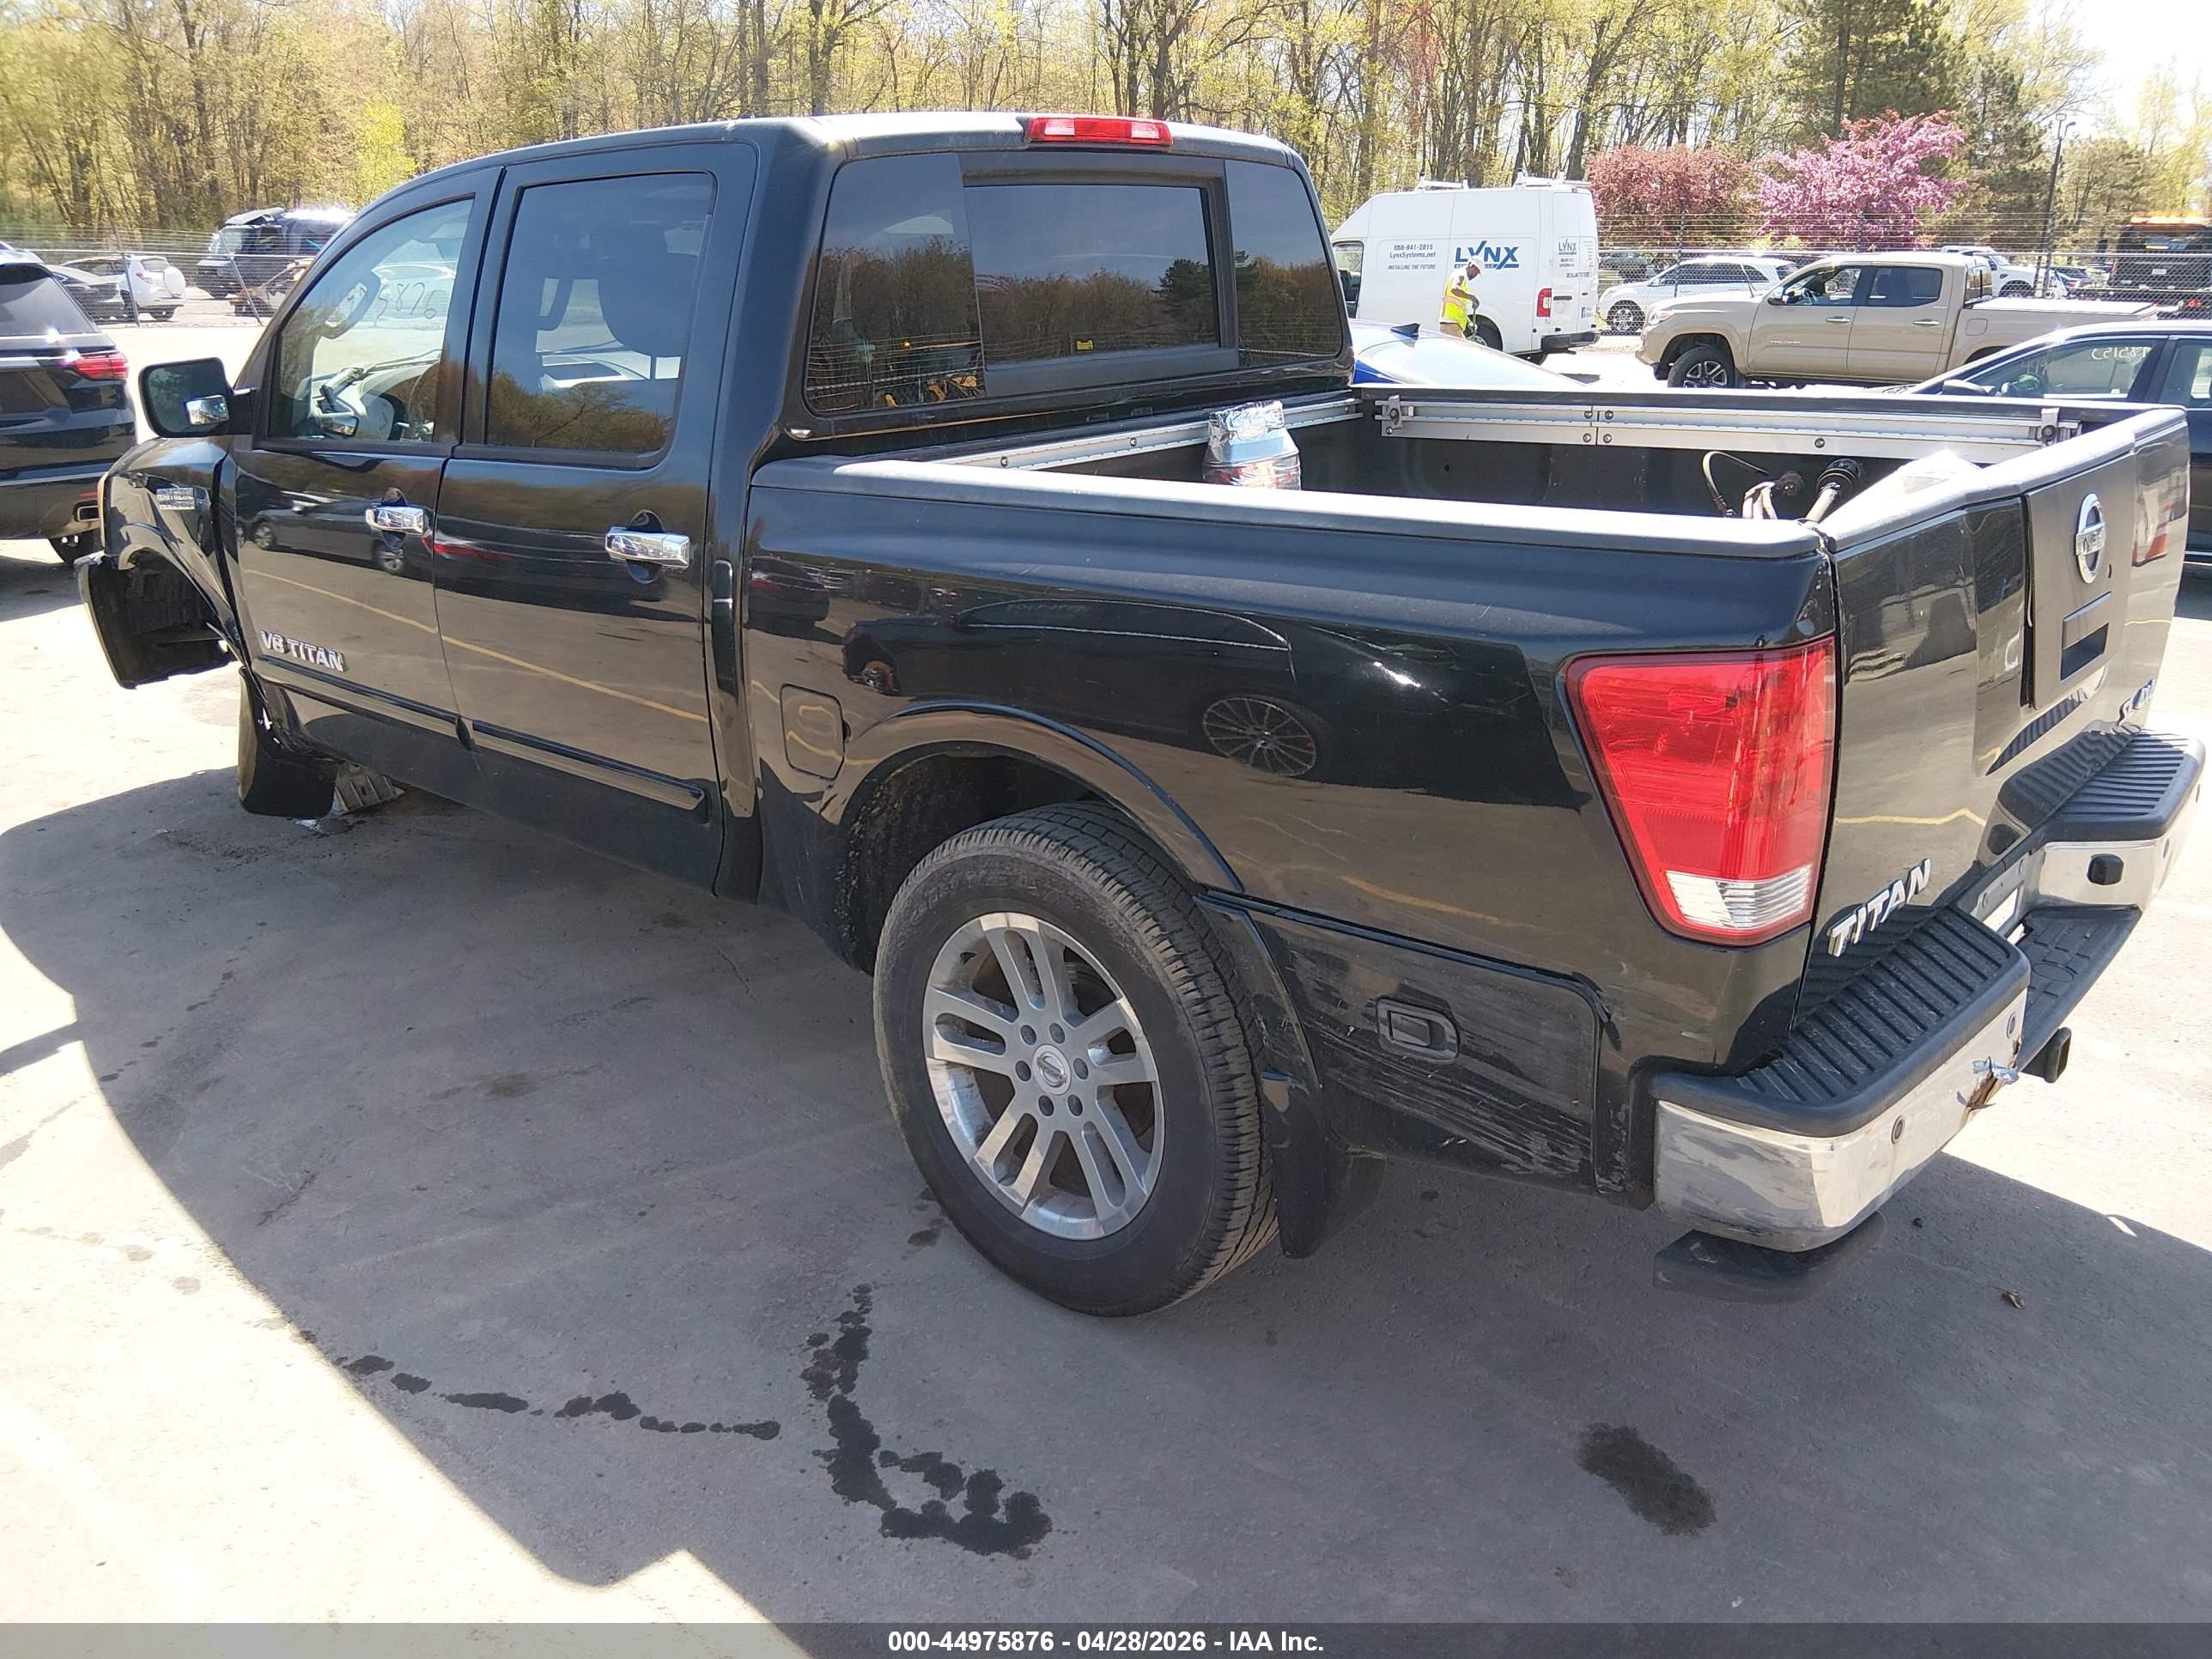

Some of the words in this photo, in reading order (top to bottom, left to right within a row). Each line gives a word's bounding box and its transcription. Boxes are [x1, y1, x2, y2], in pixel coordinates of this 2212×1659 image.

[1455, 240, 1519, 269] LYNX
[1559, 239, 1577, 255] LYNX
[261, 630, 286, 653] V8
[288, 639, 344, 672] TITAN
[1827, 859, 1931, 957] TITAN
